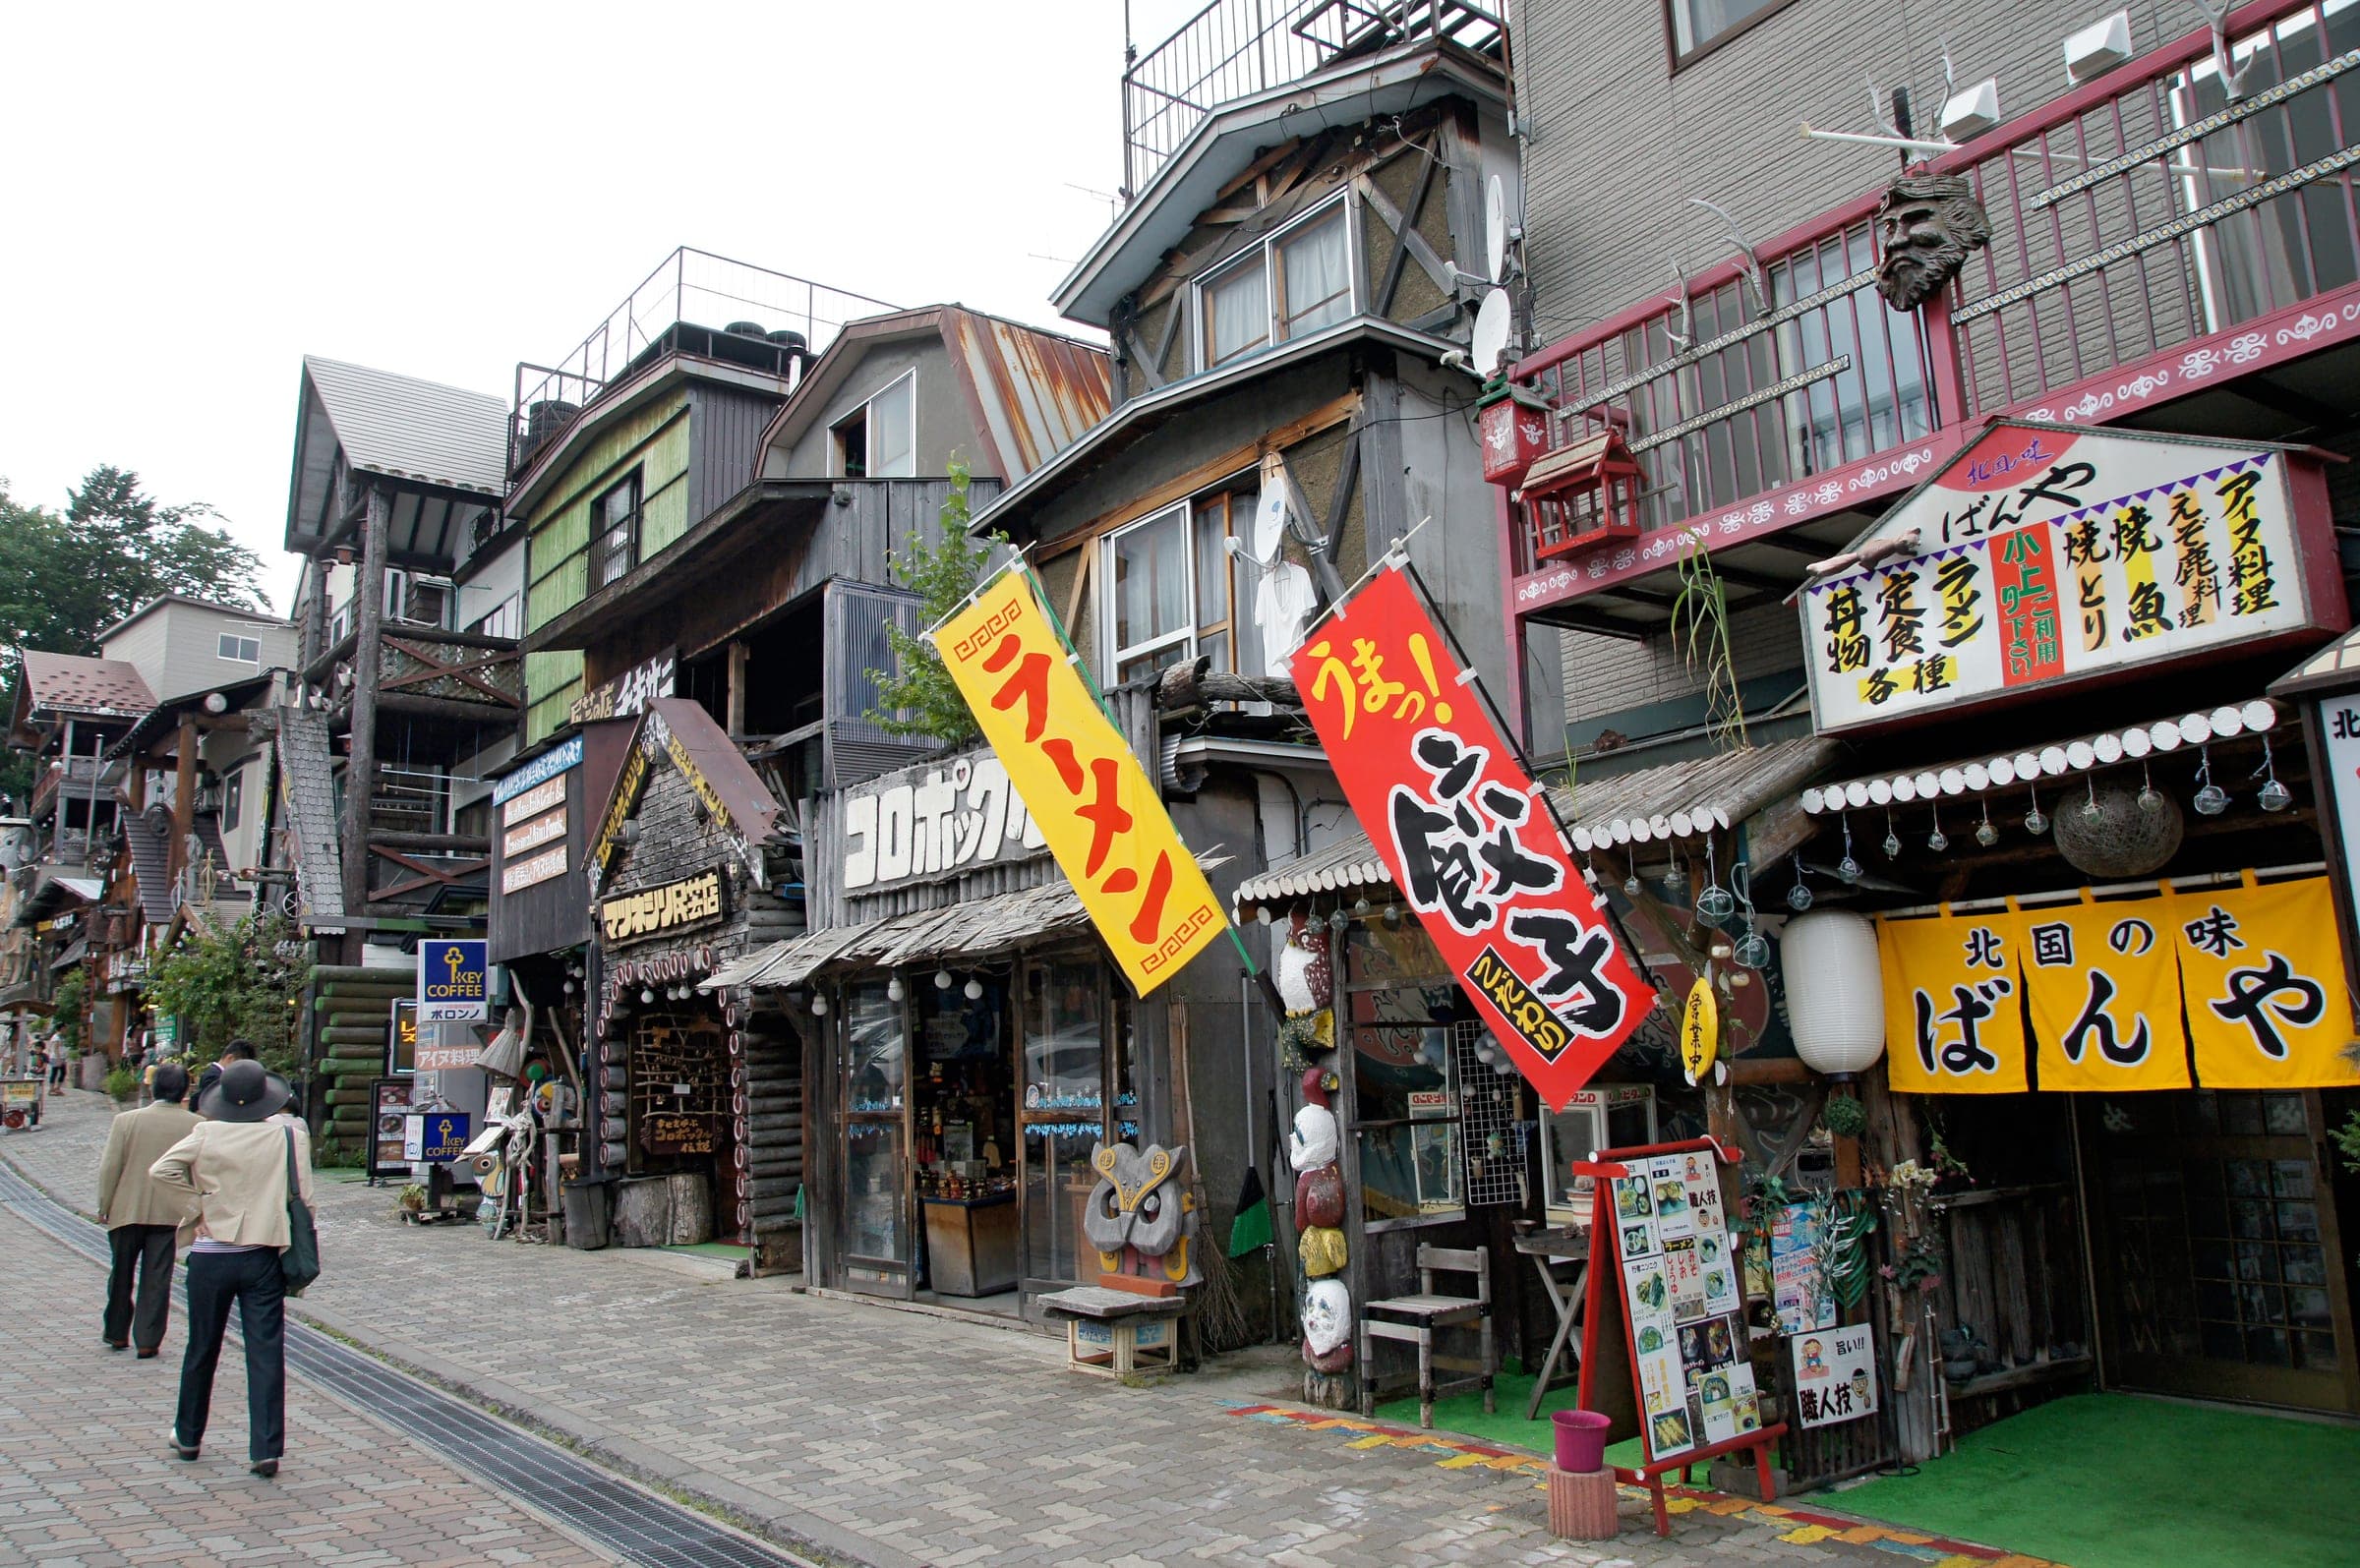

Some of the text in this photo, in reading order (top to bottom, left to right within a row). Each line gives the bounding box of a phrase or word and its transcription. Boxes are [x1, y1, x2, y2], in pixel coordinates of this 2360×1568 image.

[1942, 462, 2096, 543] ばんや
[2215, 470, 2279, 615] アイヌ料理
[2063, 521, 2110, 651] 焼とり
[2110, 505, 2173, 642] 焼魚
[2167, 493, 2221, 628] えぞ鹿料理
[1825, 587, 1871, 673] 丼物
[1876, 572, 1927, 663] 定食
[1933, 555, 1983, 648] ラーメン
[1863, 654, 1951, 704] 各種
[982, 634, 1173, 944] ラーメン
[1390, 731, 1623, 1036] 餃子
[1965, 905, 2244, 968] 北国の味
[427, 985, 482, 997] COFFEE
[456, 972, 483, 983] KEY
[1915, 951, 2326, 1075] ばんや
[418, 1048, 481, 1067] アイヌ料理
[1666, 1239, 1693, 1250] ラーメン
[1667, 1254, 1678, 1294] しょうゆ
[1678, 1252, 1686, 1279] しお
[1688, 1249, 1697, 1276] みそ
[1800, 1382, 1853, 1423] 職人技
